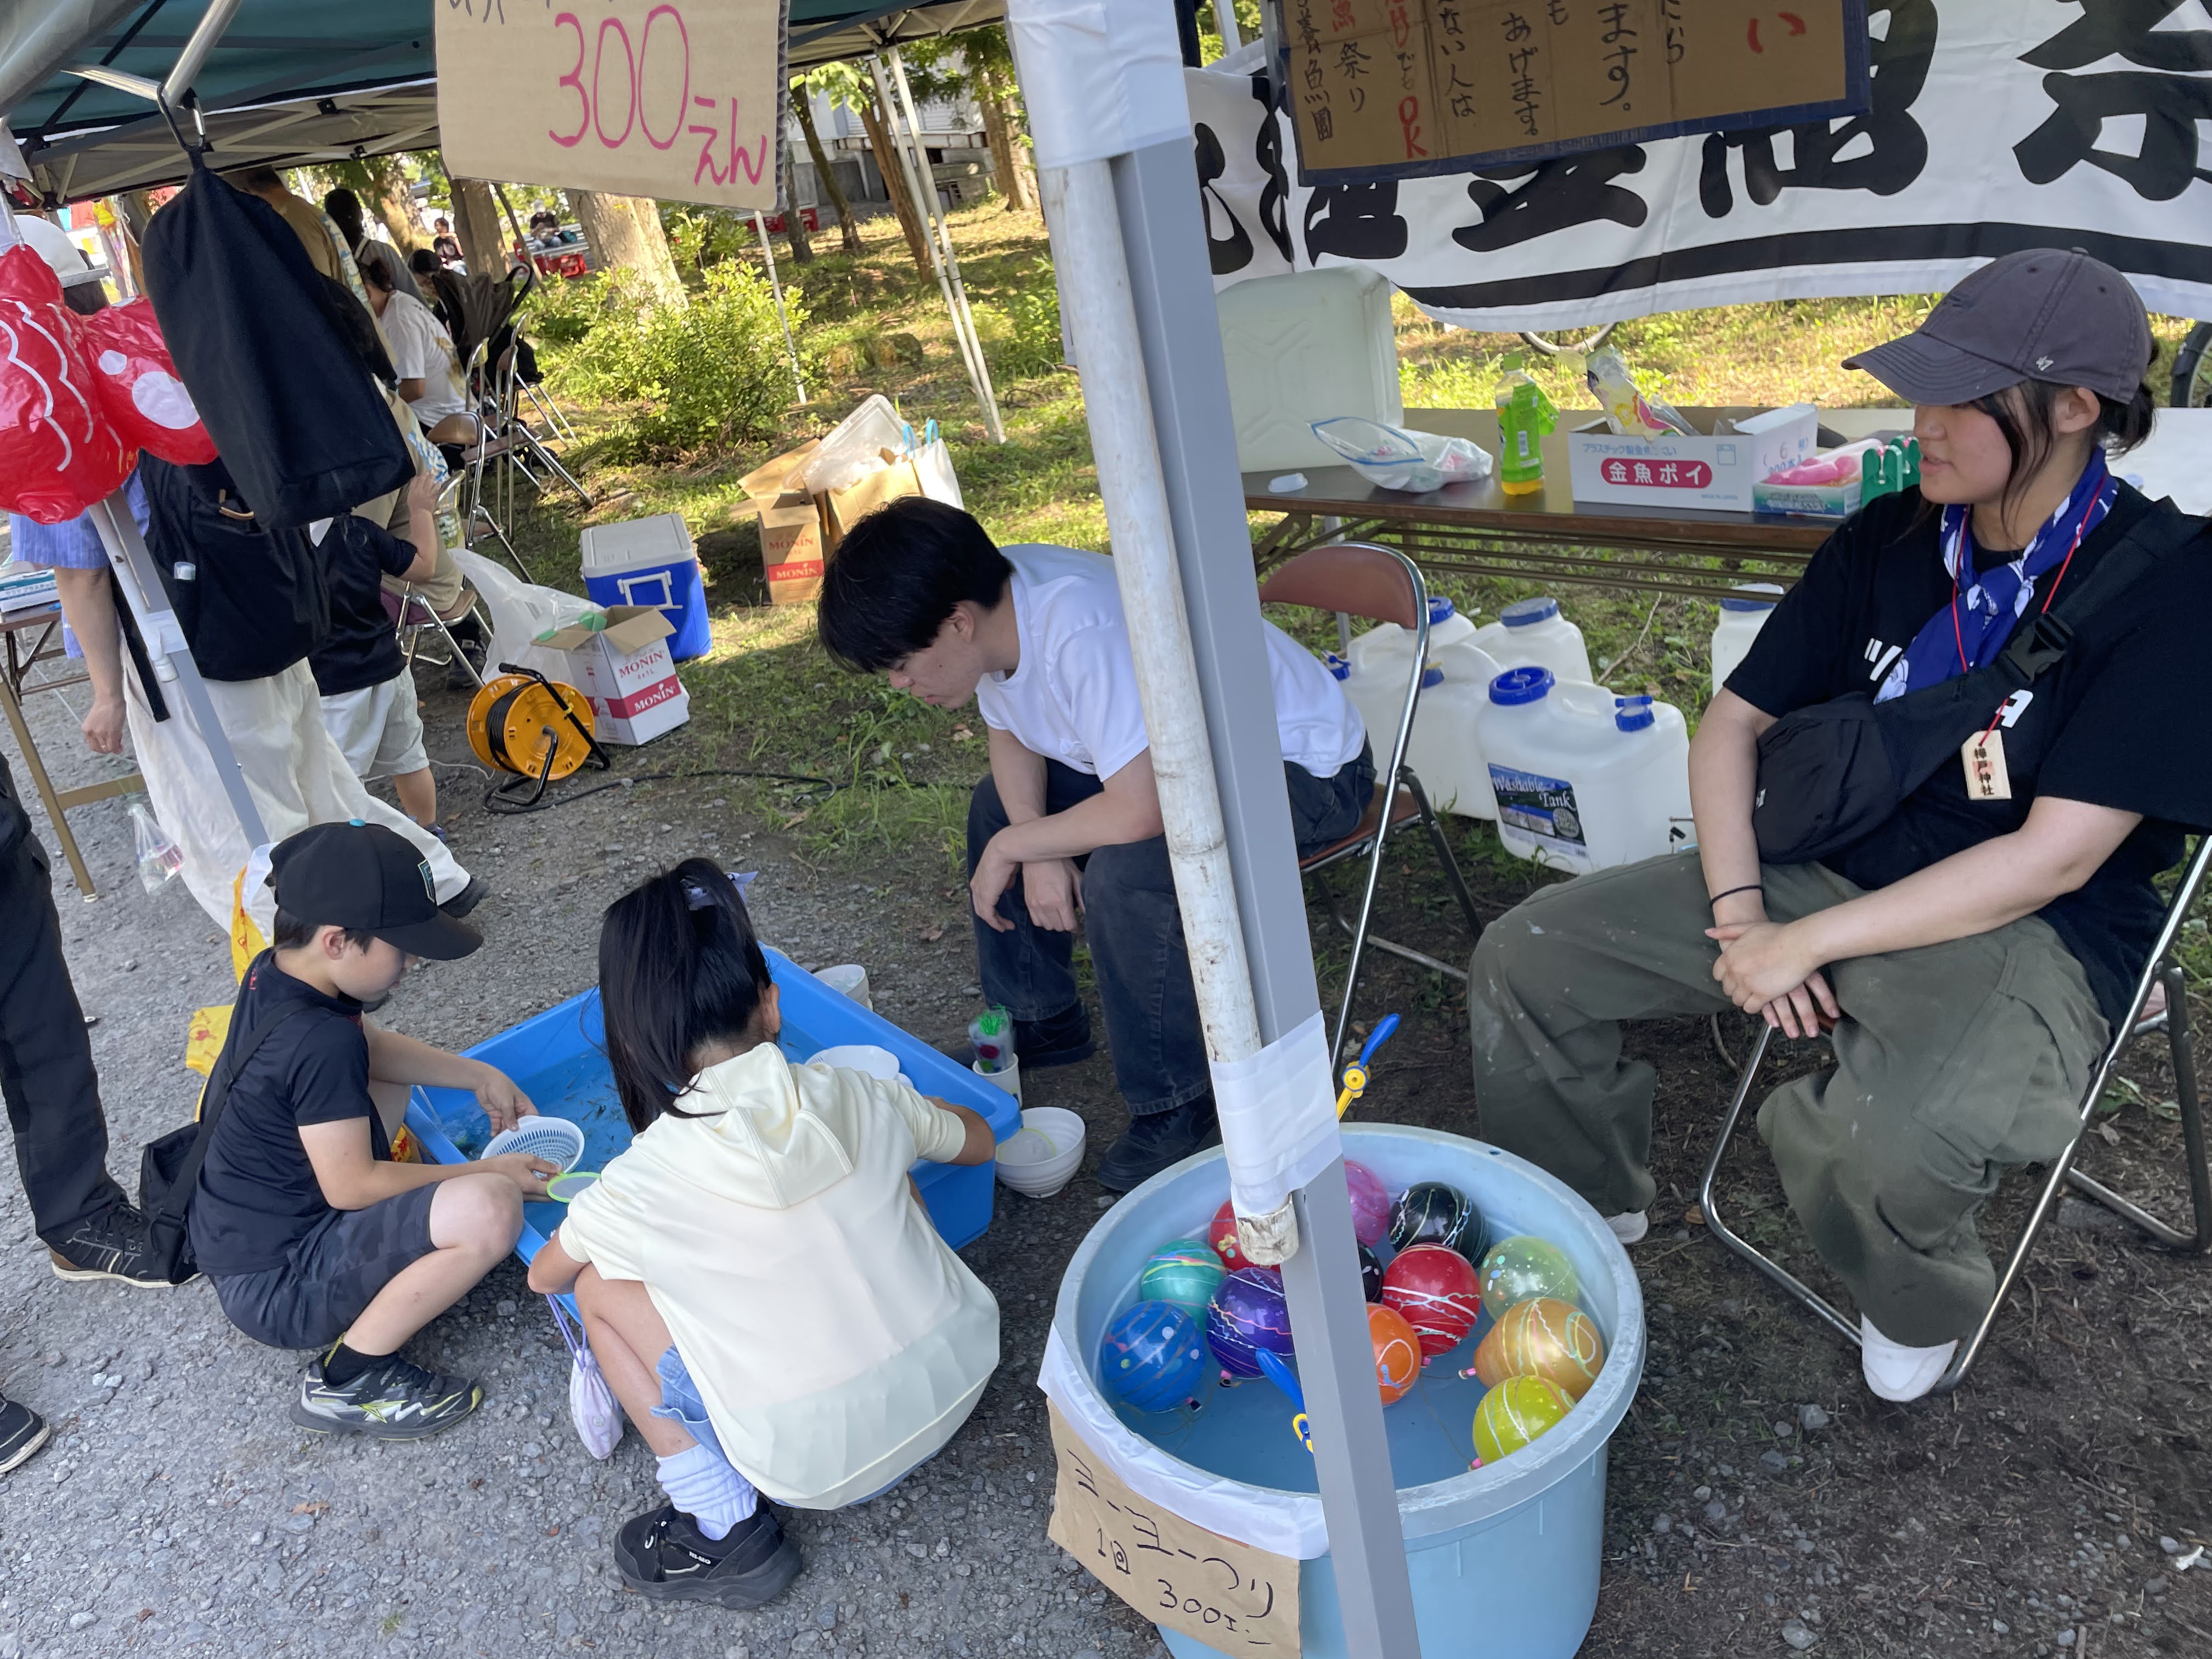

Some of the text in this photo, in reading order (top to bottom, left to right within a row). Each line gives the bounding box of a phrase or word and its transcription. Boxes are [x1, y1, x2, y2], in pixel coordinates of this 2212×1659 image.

[1438, 0, 1476, 117] ない人は
[1598, 3, 1637, 110] ます。
[1501, 12, 1541, 136] あげます。
[549, 4, 767, 187] 300えん
[1608, 461, 1702, 486] 金魚ポイ
[769, 537, 814, 550] MONIN
[776, 562, 817, 579] MONIN
[618, 649, 663, 679] MONIN
[634, 683, 675, 712] MONIN
[1492, 775, 1545, 793] Washable
[1539, 791, 1577, 812] Tank
[1066, 1448, 1274, 1619] ヨーヨーつり
